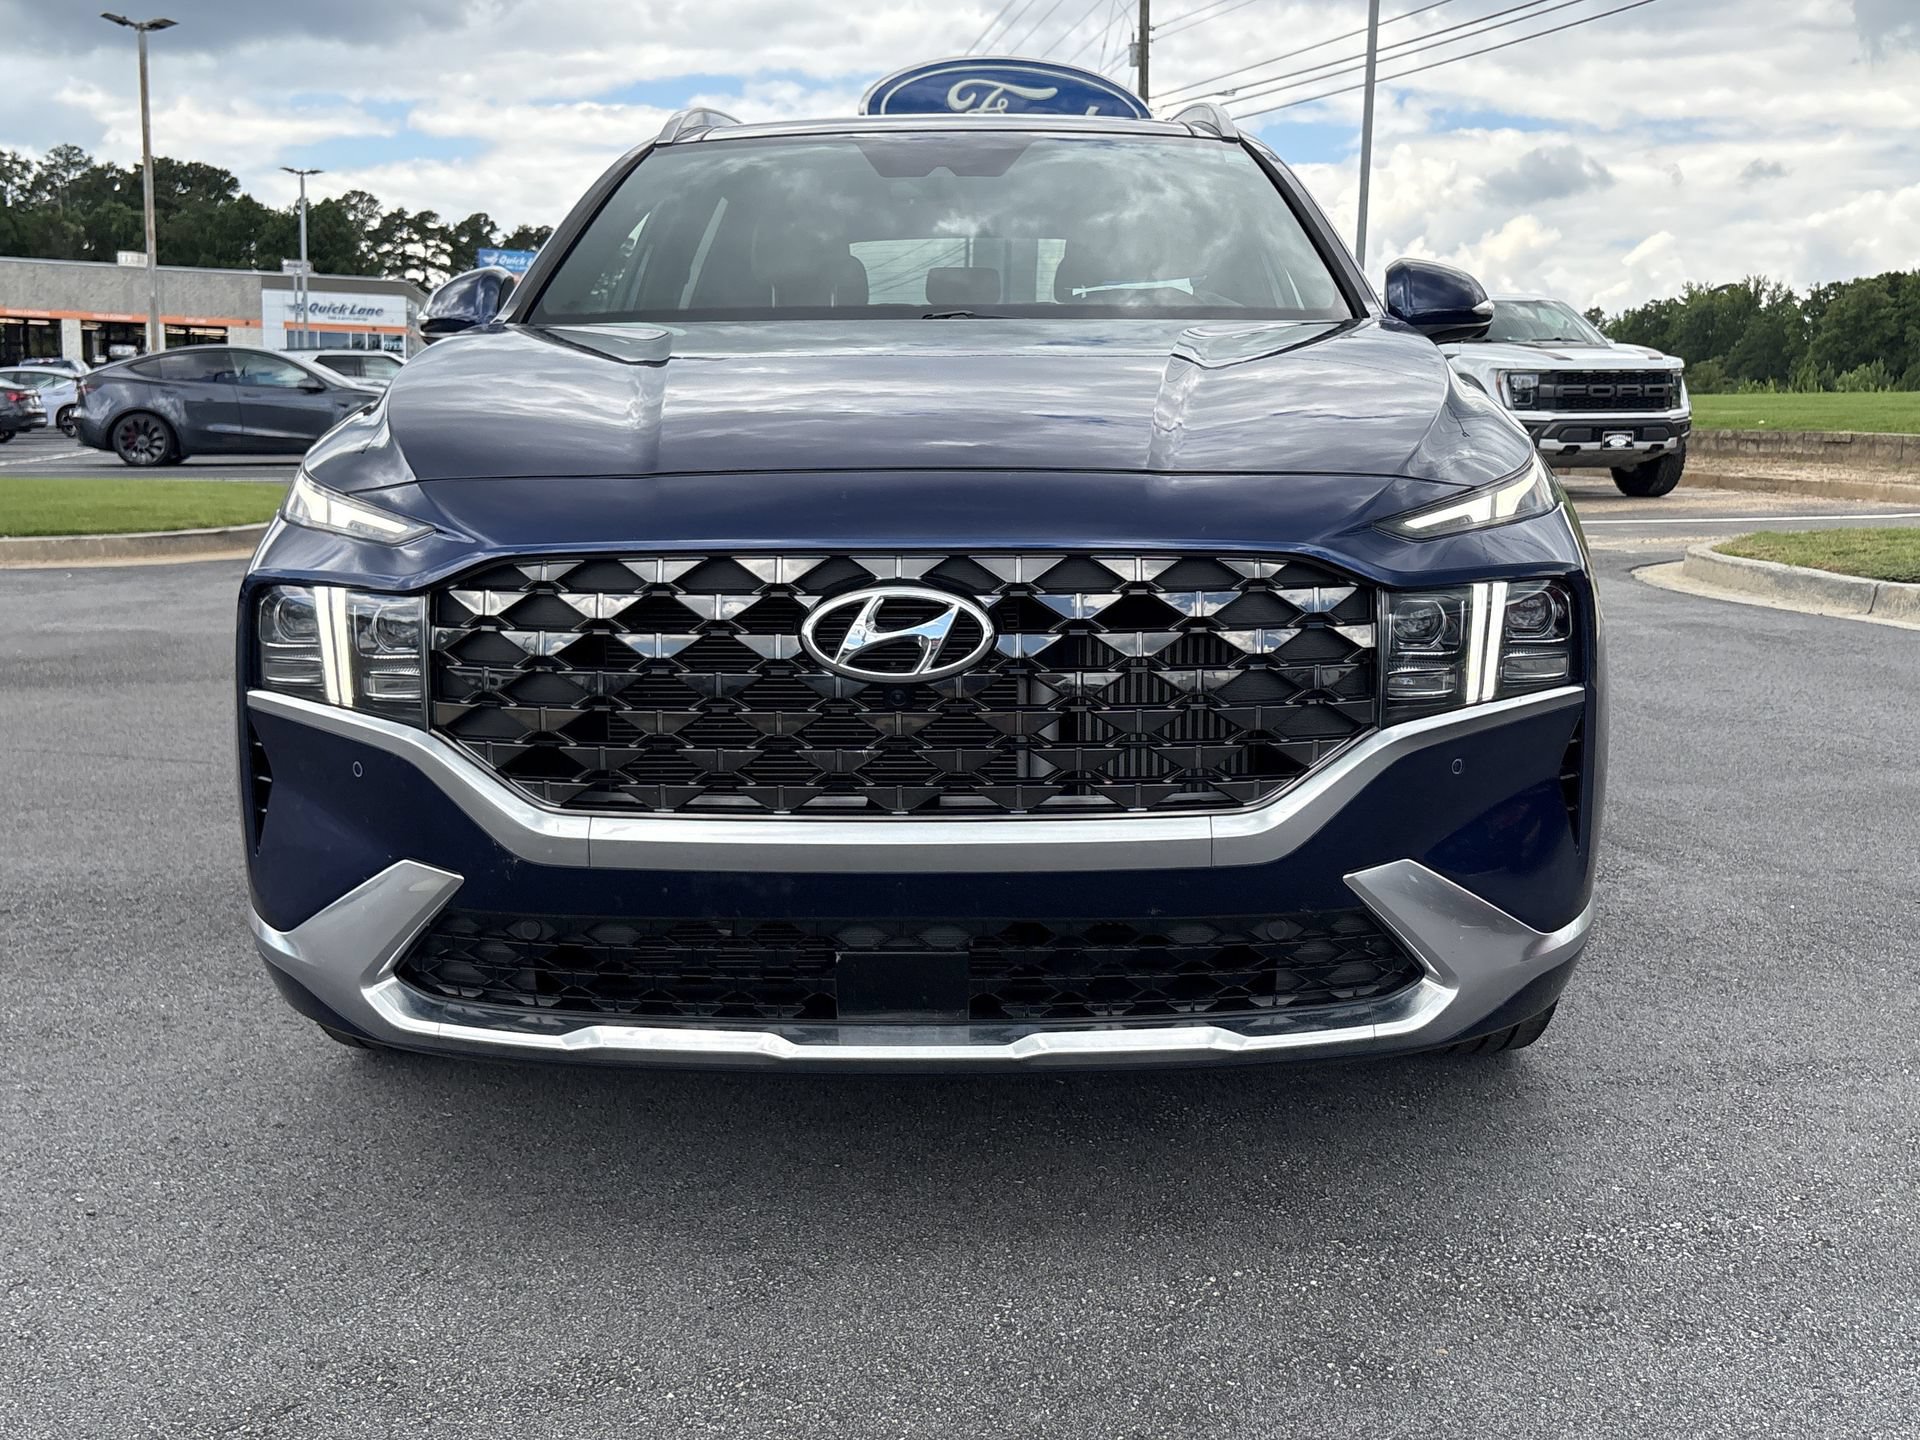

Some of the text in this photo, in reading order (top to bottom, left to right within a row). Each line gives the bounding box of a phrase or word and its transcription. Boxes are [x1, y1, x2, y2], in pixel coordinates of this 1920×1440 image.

[499, 254, 527, 266] Quick
[309, 302, 384, 316] Quick Lane
[1557, 384, 1669, 397] FORD
